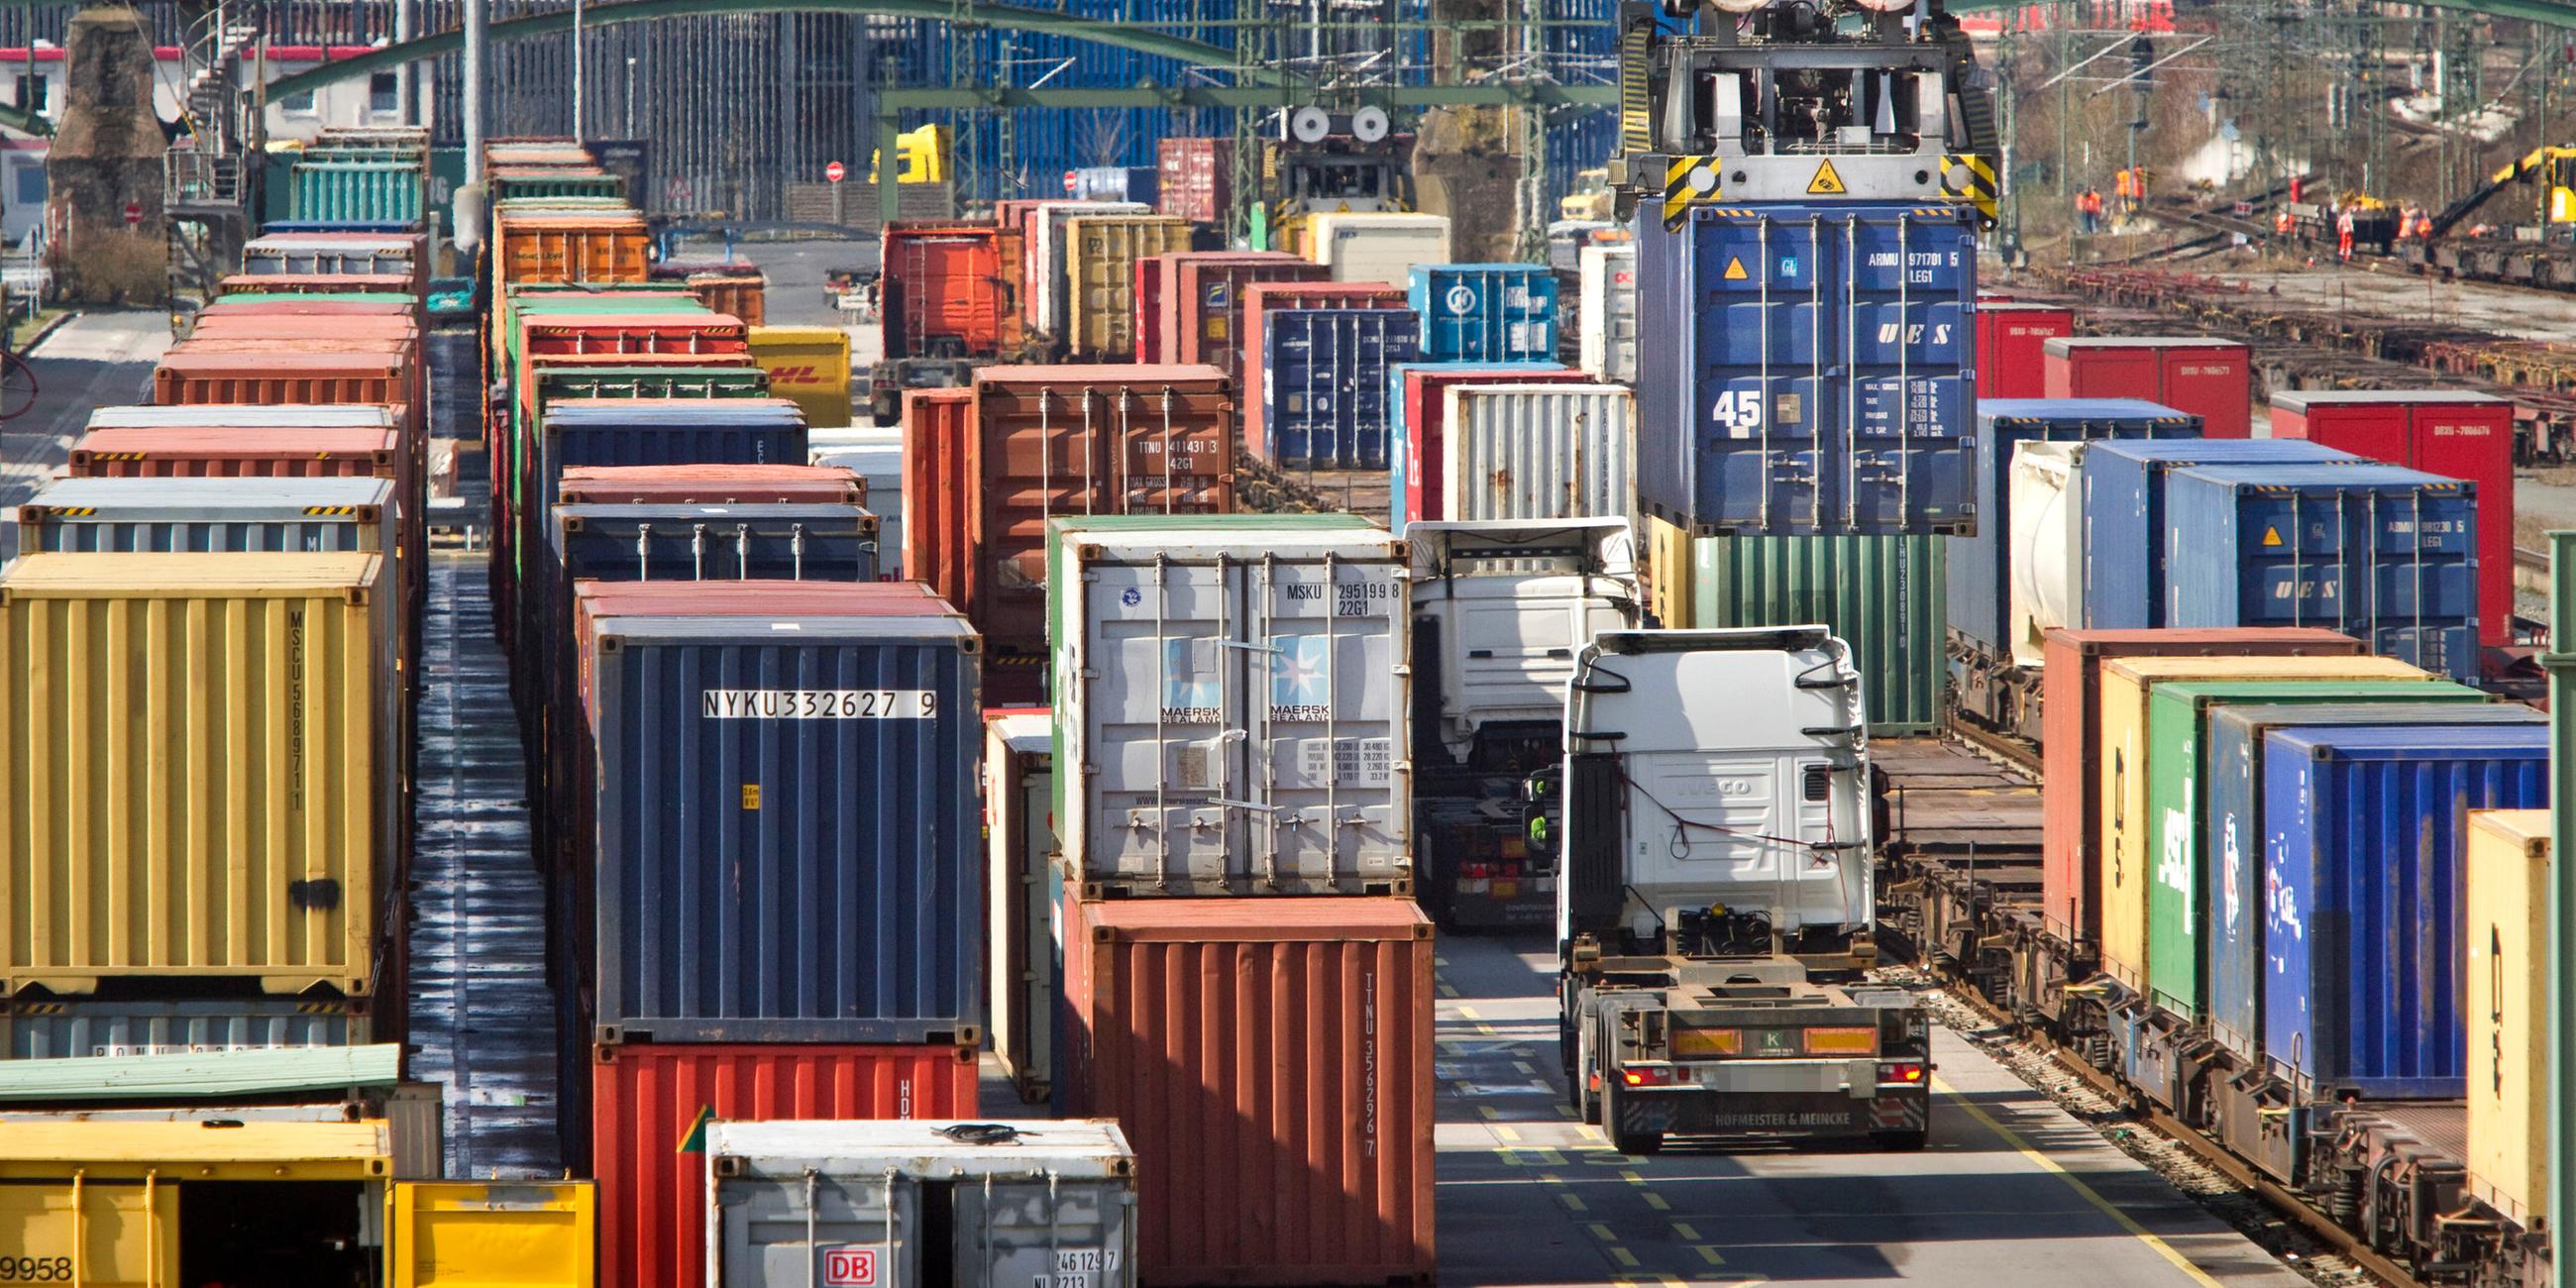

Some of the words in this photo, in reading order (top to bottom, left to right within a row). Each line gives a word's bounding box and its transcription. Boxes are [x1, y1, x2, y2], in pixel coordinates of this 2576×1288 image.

[1782, 260, 1797, 273] GL
[1869, 253, 1898, 267] ARMU
[1908, 253, 1942, 267] 971701
[1950, 253, 1958, 267] 5
[1909, 270, 1932, 283] LEG1
[1713, 390, 1761, 427] 45
[1138, 442, 1161, 454] TTNU
[1169, 442, 1204, 454] 411431
[1211, 442, 1217, 454] 3
[1170, 458, 1193, 470] 42G1
[2456, 520, 2464, 533] 5
[1287, 585, 1322, 599] MSKU
[1339, 584, 1386, 599] 295199
[1392, 584, 1399, 598] 8
[1339, 600, 1368, 615] 22G1
[1161, 707, 1220, 716] MAERSK
[1271, 705, 1329, 715] MAERSK
[1675, 780, 1751, 795] IVECO
[1768, 1033, 1778, 1046] K
[1715, 1115, 1787, 1127] HOFMEISTER
[1788, 1114, 1798, 1126] &
[1799, 1113, 1851, 1126] MEINCKE
[831, 1256, 869, 1278] DB
[1109, 1252, 1116, 1270] 7
[0, 1256, 72, 1281] 9958
